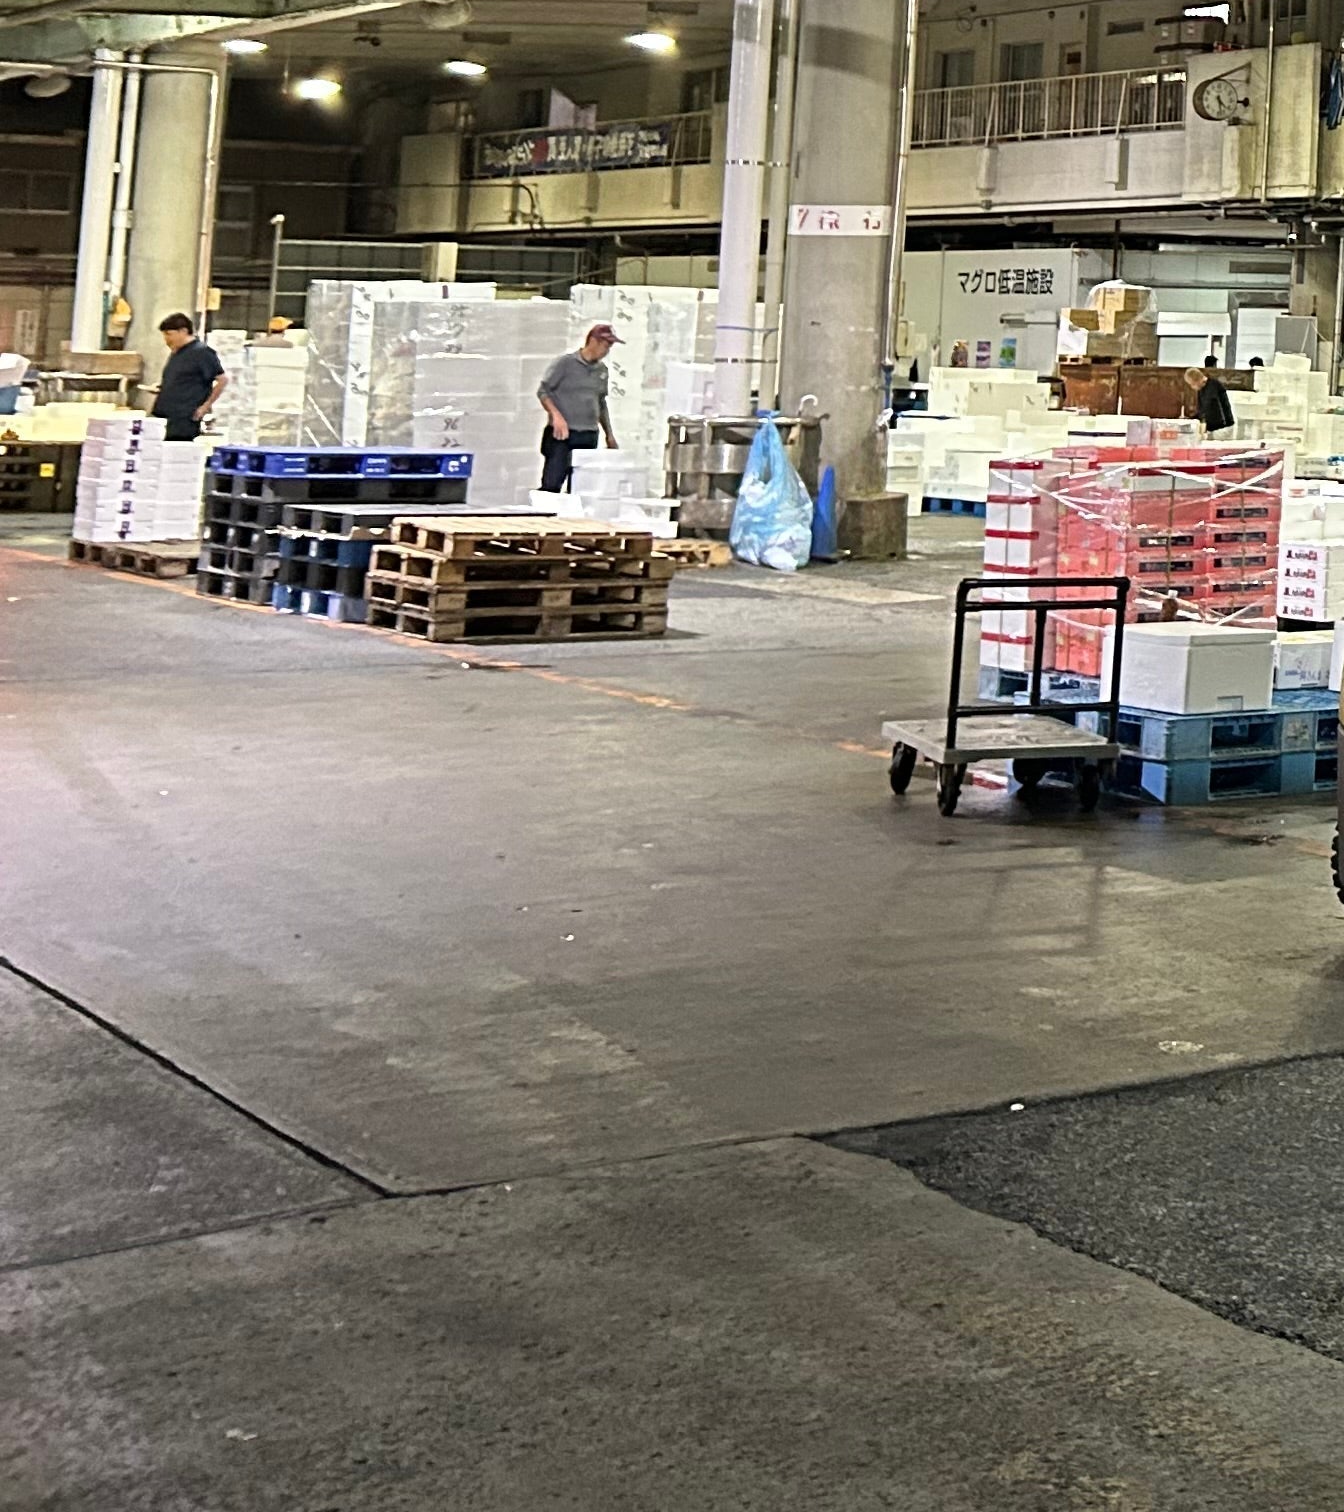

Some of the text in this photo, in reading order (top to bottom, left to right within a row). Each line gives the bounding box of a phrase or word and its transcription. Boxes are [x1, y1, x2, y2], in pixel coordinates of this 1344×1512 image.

[957, 267, 1054, 295] マグロ低温施設
